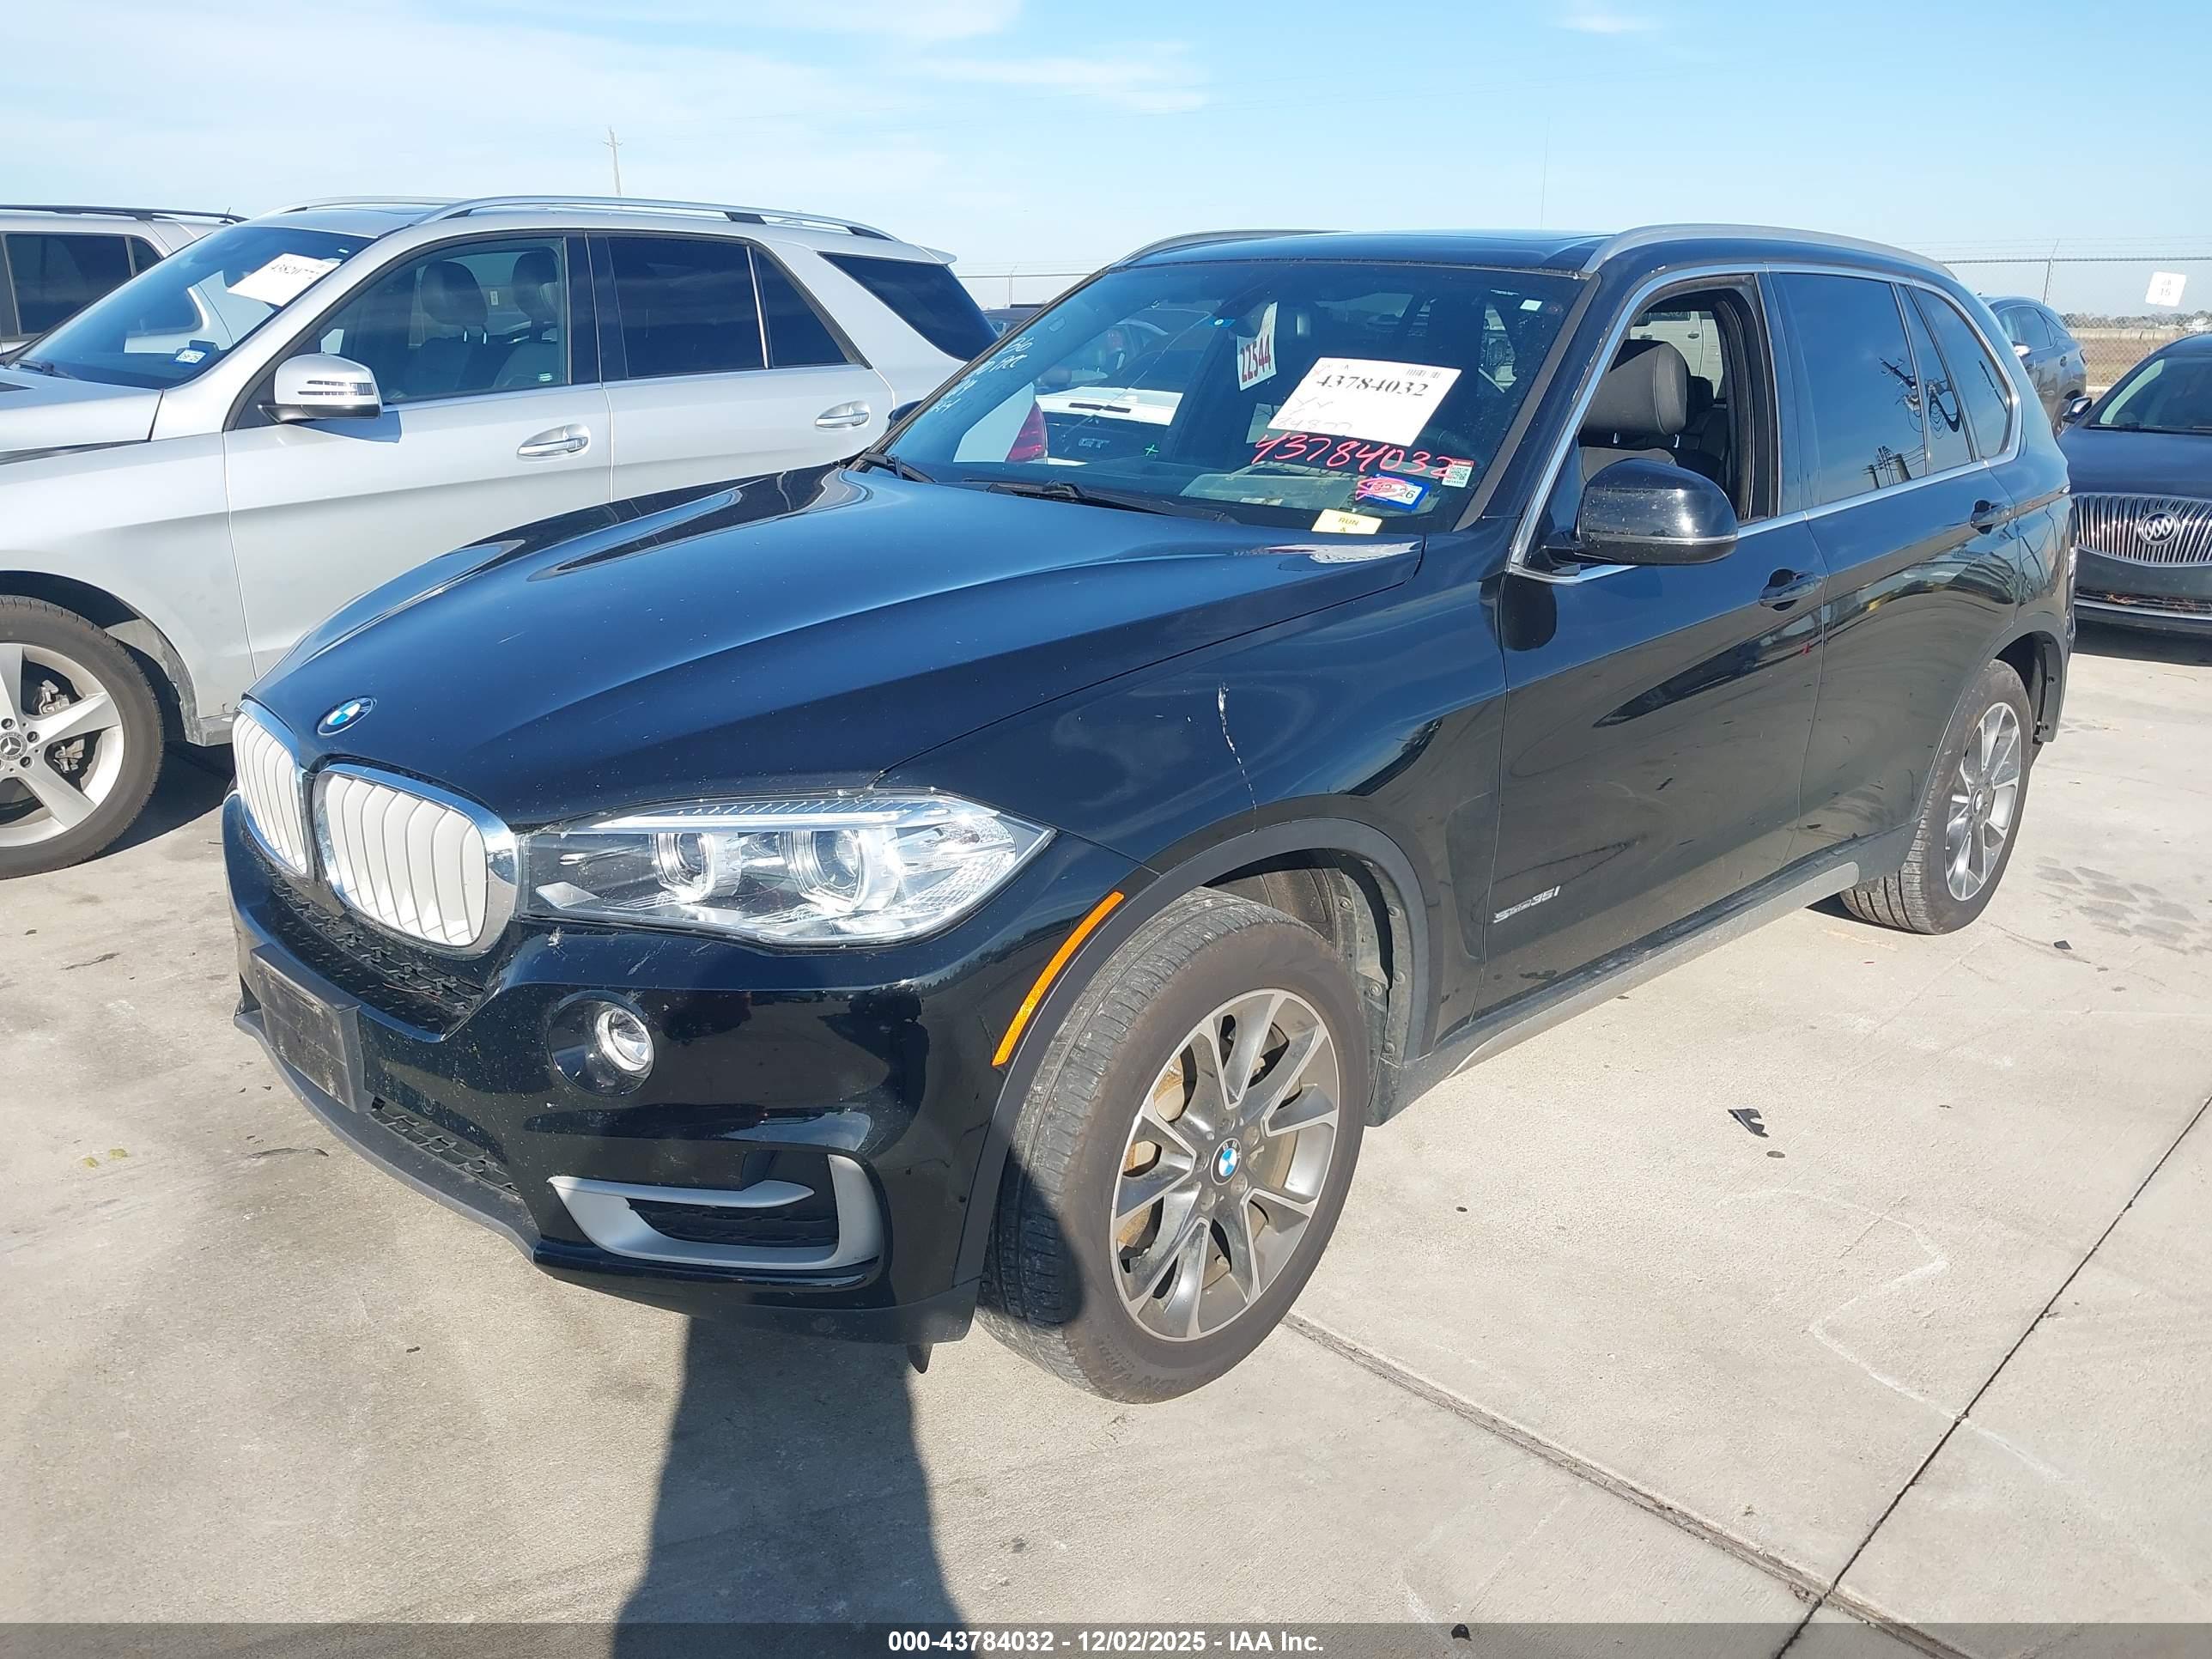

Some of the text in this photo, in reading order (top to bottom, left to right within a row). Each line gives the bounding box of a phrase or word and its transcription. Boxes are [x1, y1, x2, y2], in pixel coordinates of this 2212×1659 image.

[1240, 334, 1272, 383] 22544
[1316, 374, 1429, 397] 43784032
[1078, 437, 1111, 449] GT
[1251, 431, 1455, 479] 43784032
[1338, 517, 1359, 526] RUN
